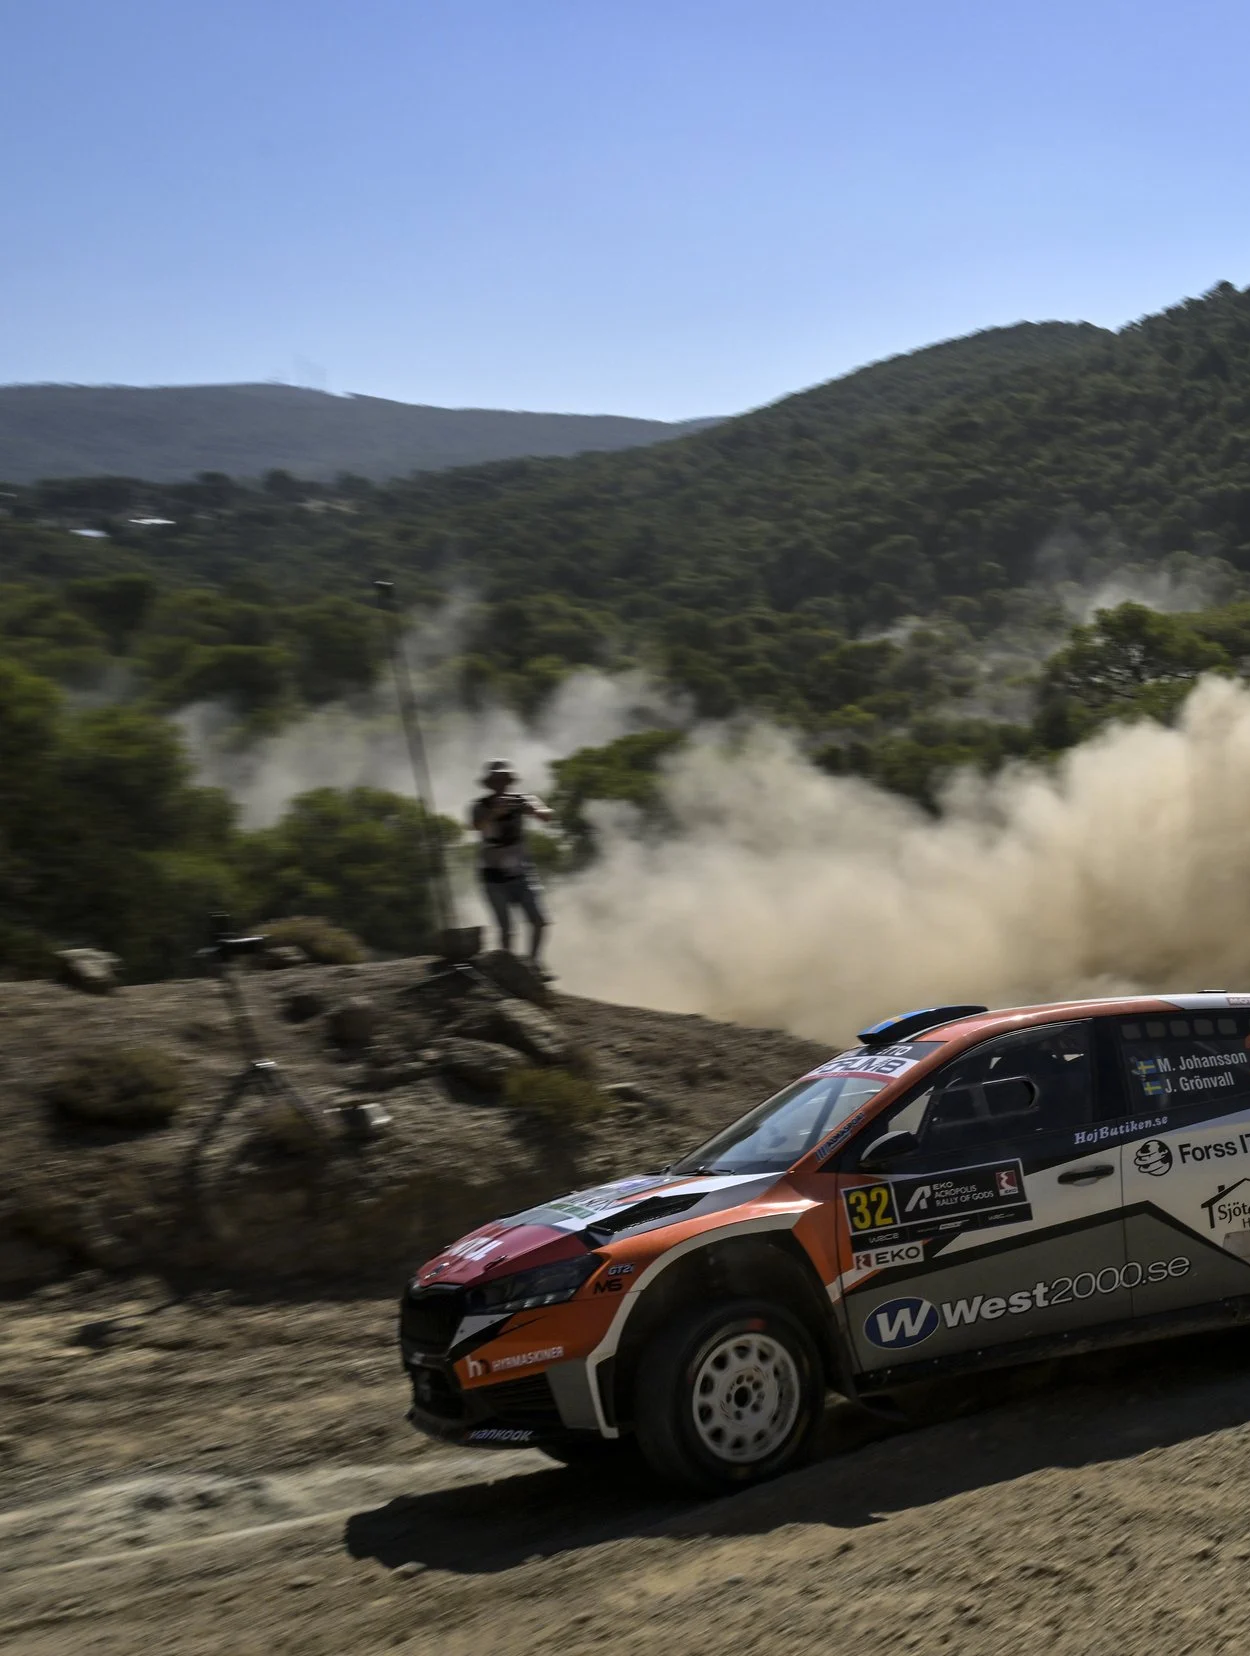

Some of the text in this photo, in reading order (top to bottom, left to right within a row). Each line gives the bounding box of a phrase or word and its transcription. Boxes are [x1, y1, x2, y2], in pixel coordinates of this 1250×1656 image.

[1157, 1052, 1248, 1073] M. Johansson
[1164, 1071, 1235, 1094] J. Grönvall
[1074, 1116, 1169, 1145] HojButiken.se
[1178, 1140, 1237, 1164] Forss
[932, 1181, 954, 1191] EKO
[934, 1184, 978, 1199] ACROPOLIS
[849, 1187, 893, 1230] 32
[935, 1190, 994, 1207] RALLY OF GODS
[875, 1246, 921, 1266] EKO
[941, 1256, 1191, 1328] West2000.se
